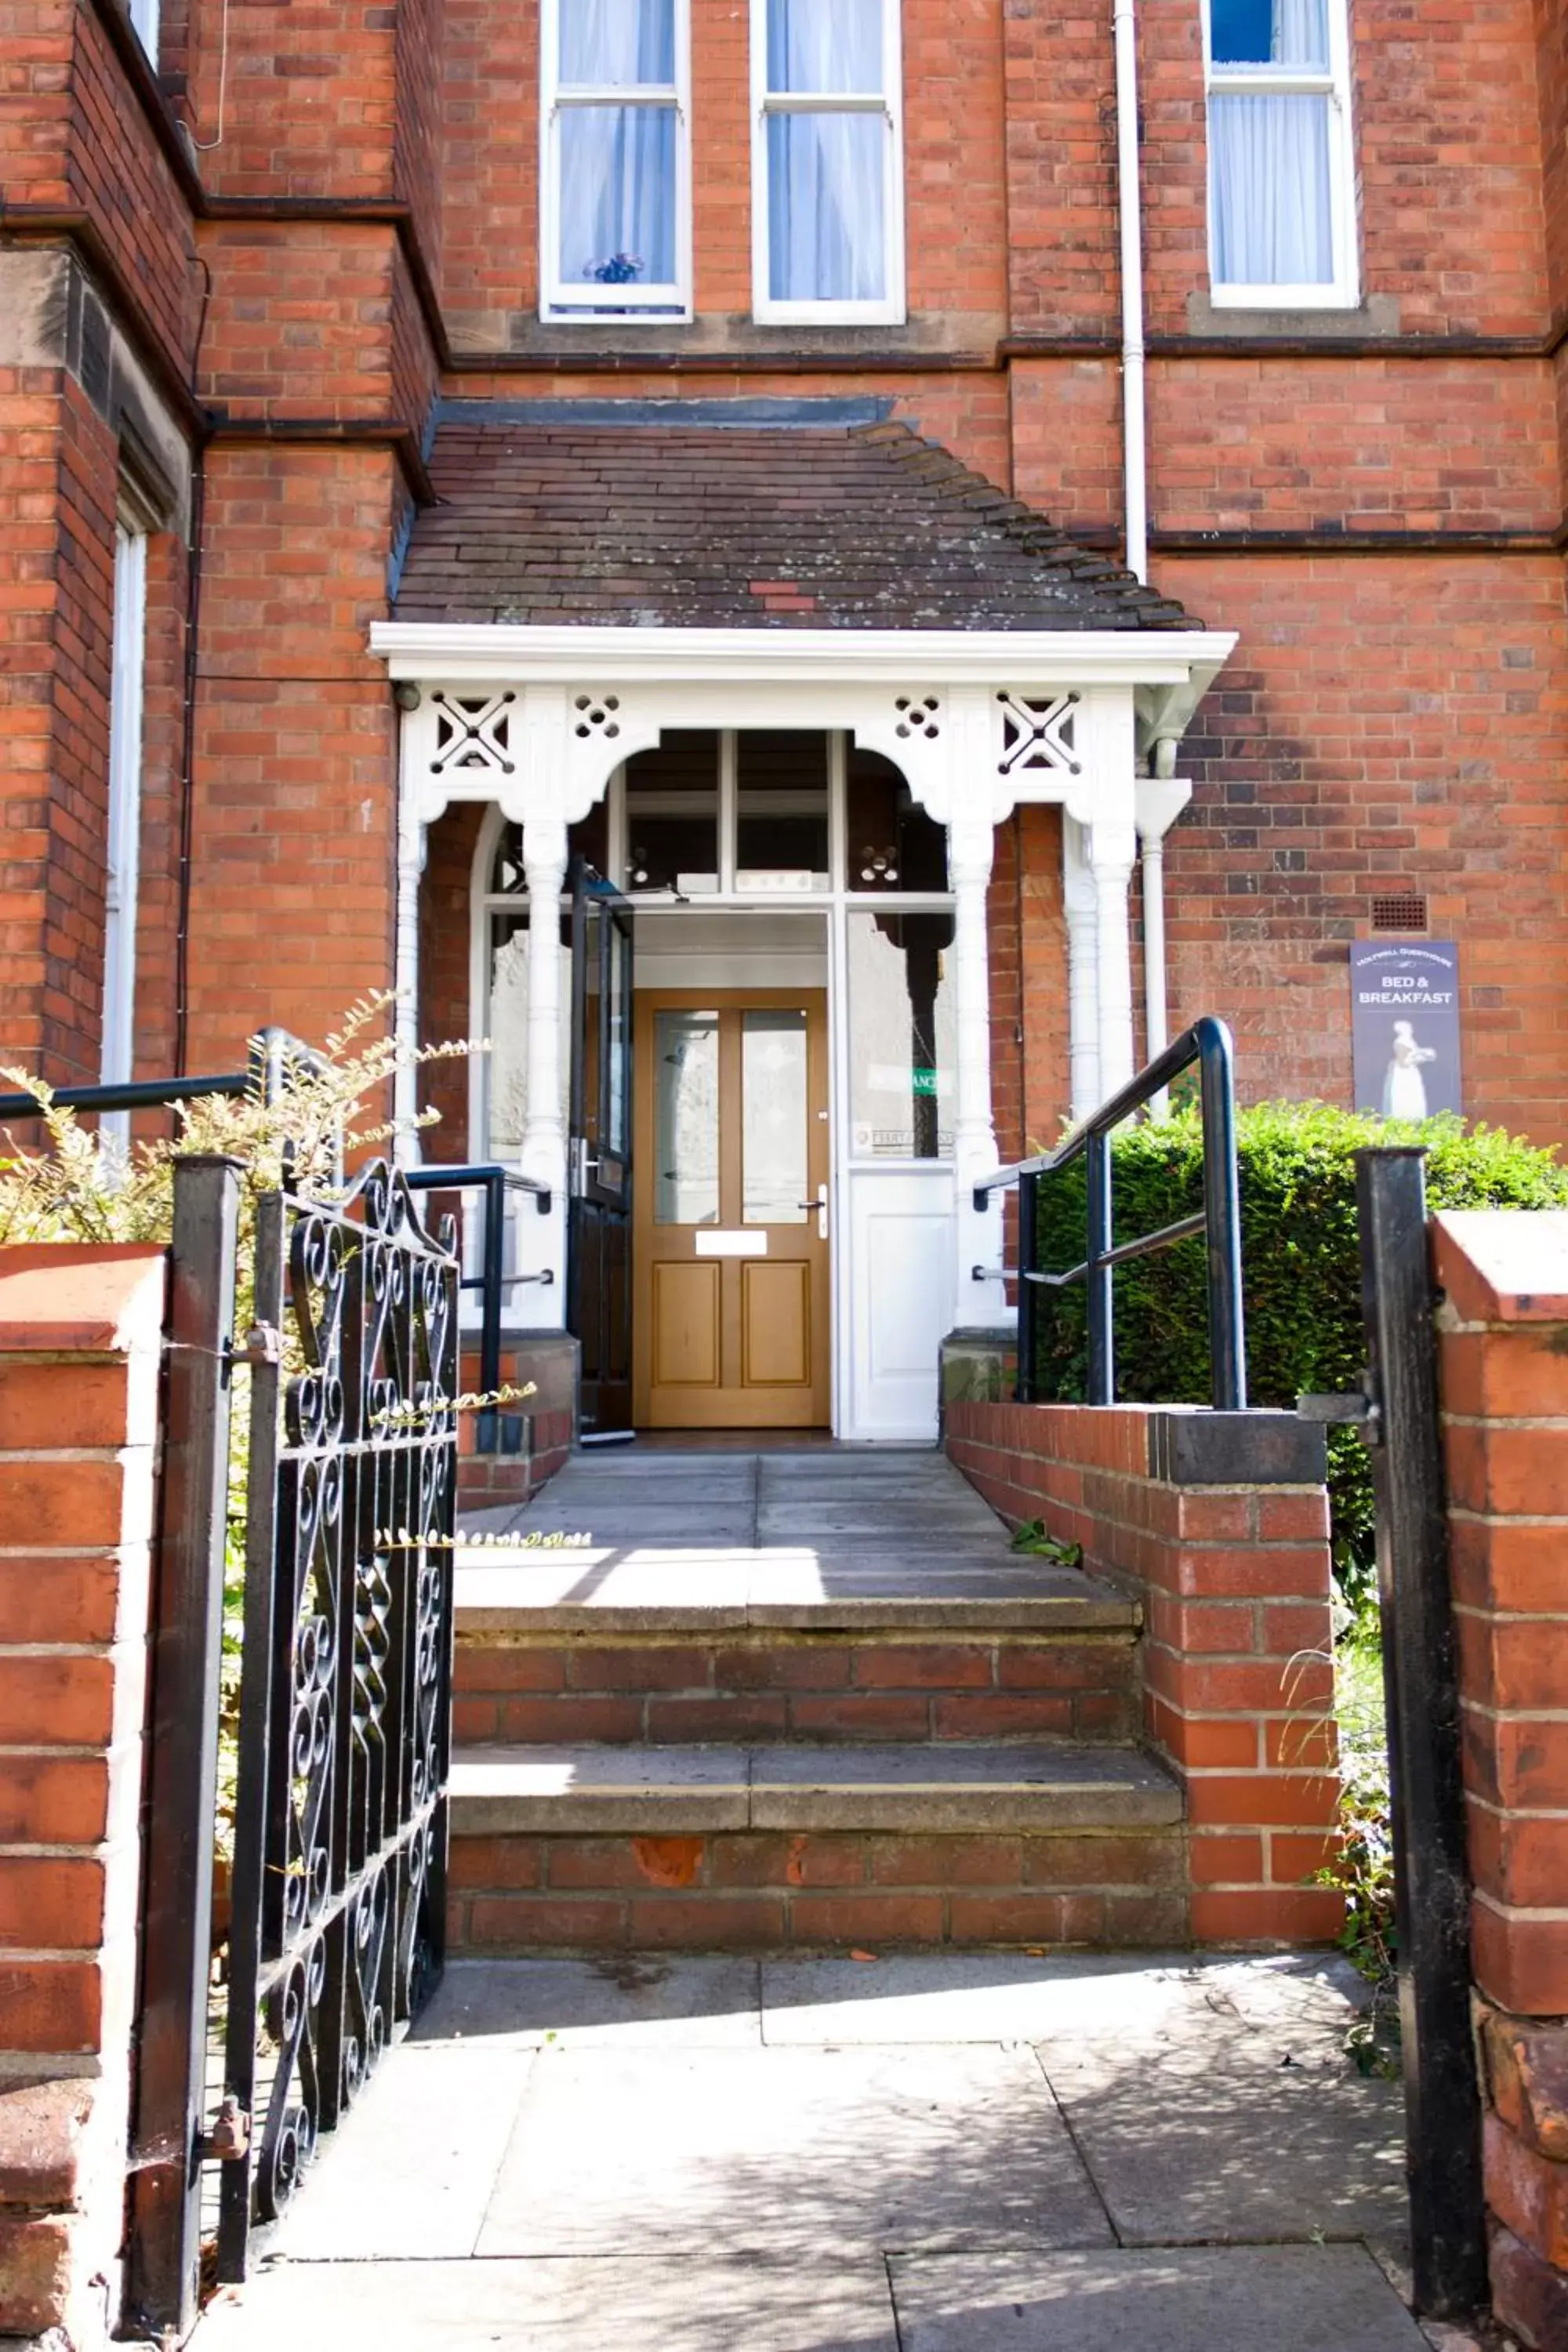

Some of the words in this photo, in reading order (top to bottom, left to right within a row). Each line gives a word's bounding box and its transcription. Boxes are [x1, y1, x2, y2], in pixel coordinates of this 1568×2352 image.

[1381, 977, 1414, 988] BED
[1417, 977, 1429, 988] &
[1359, 992, 1453, 1004] BREAKFAST
